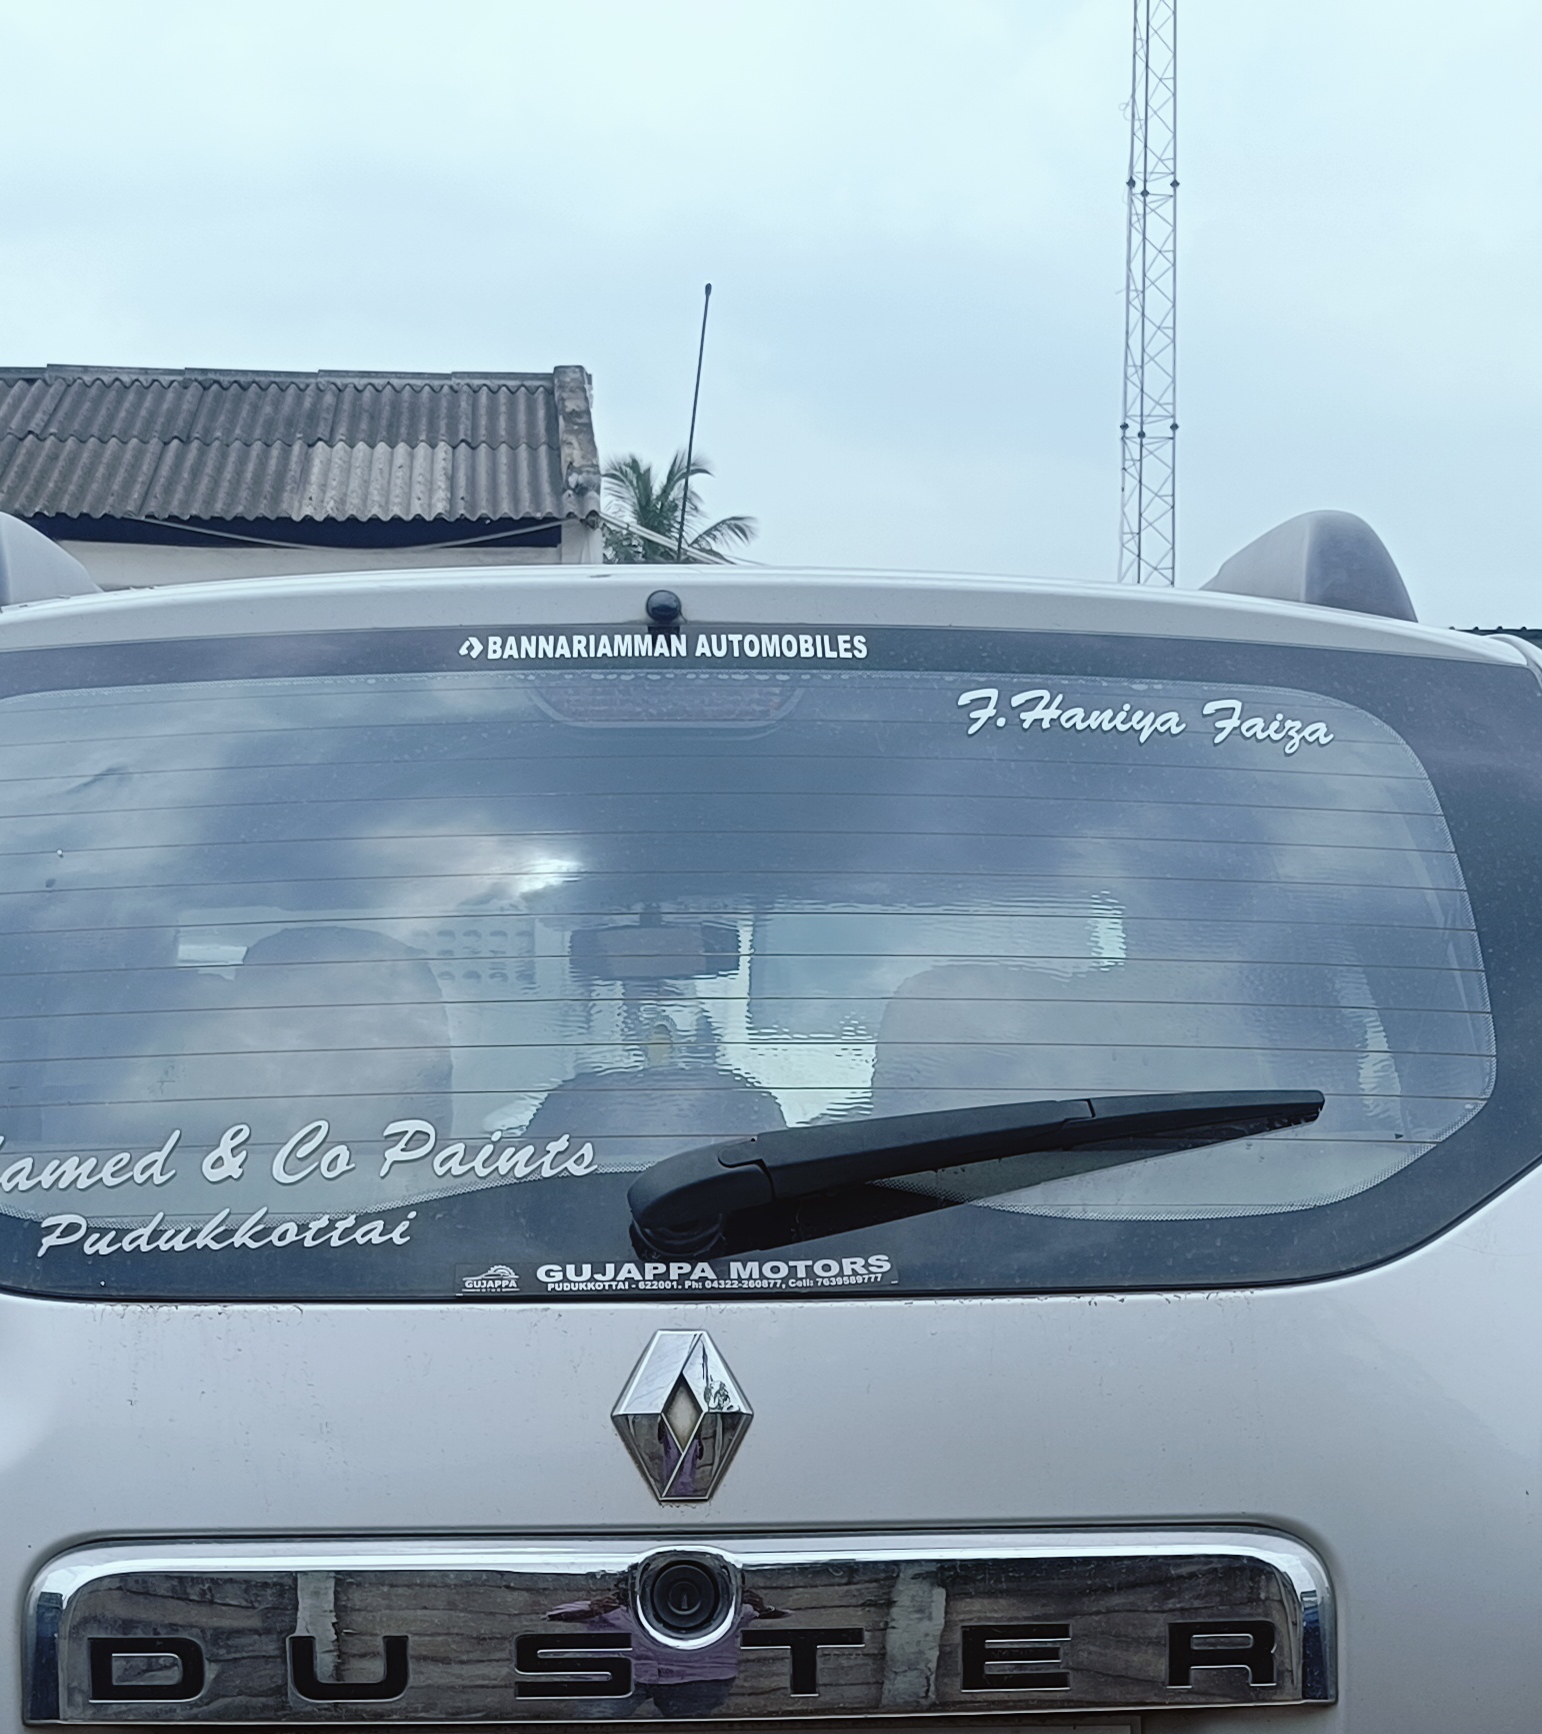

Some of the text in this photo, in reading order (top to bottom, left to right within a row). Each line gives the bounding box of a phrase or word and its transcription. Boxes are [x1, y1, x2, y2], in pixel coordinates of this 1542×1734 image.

[487, 633, 868, 660] BANNARIAMMAN AUTOMOBILES
[1202, 699, 1334, 754] Faiza
[202, 1124, 251, 1182] &
[272, 1120, 356, 1185] Co
[380, 1119, 598, 1178] Paints
[38, 1207, 418, 1258] Pudukkottai
[464, 1279, 518, 1288] GUJAPPA
[536, 1254, 892, 1282] GUJAPPA MOTORS
[547, 1281, 629, 1291] PUDUKKOTTAI
[87, 1620, 1277, 1704] DUSTER
